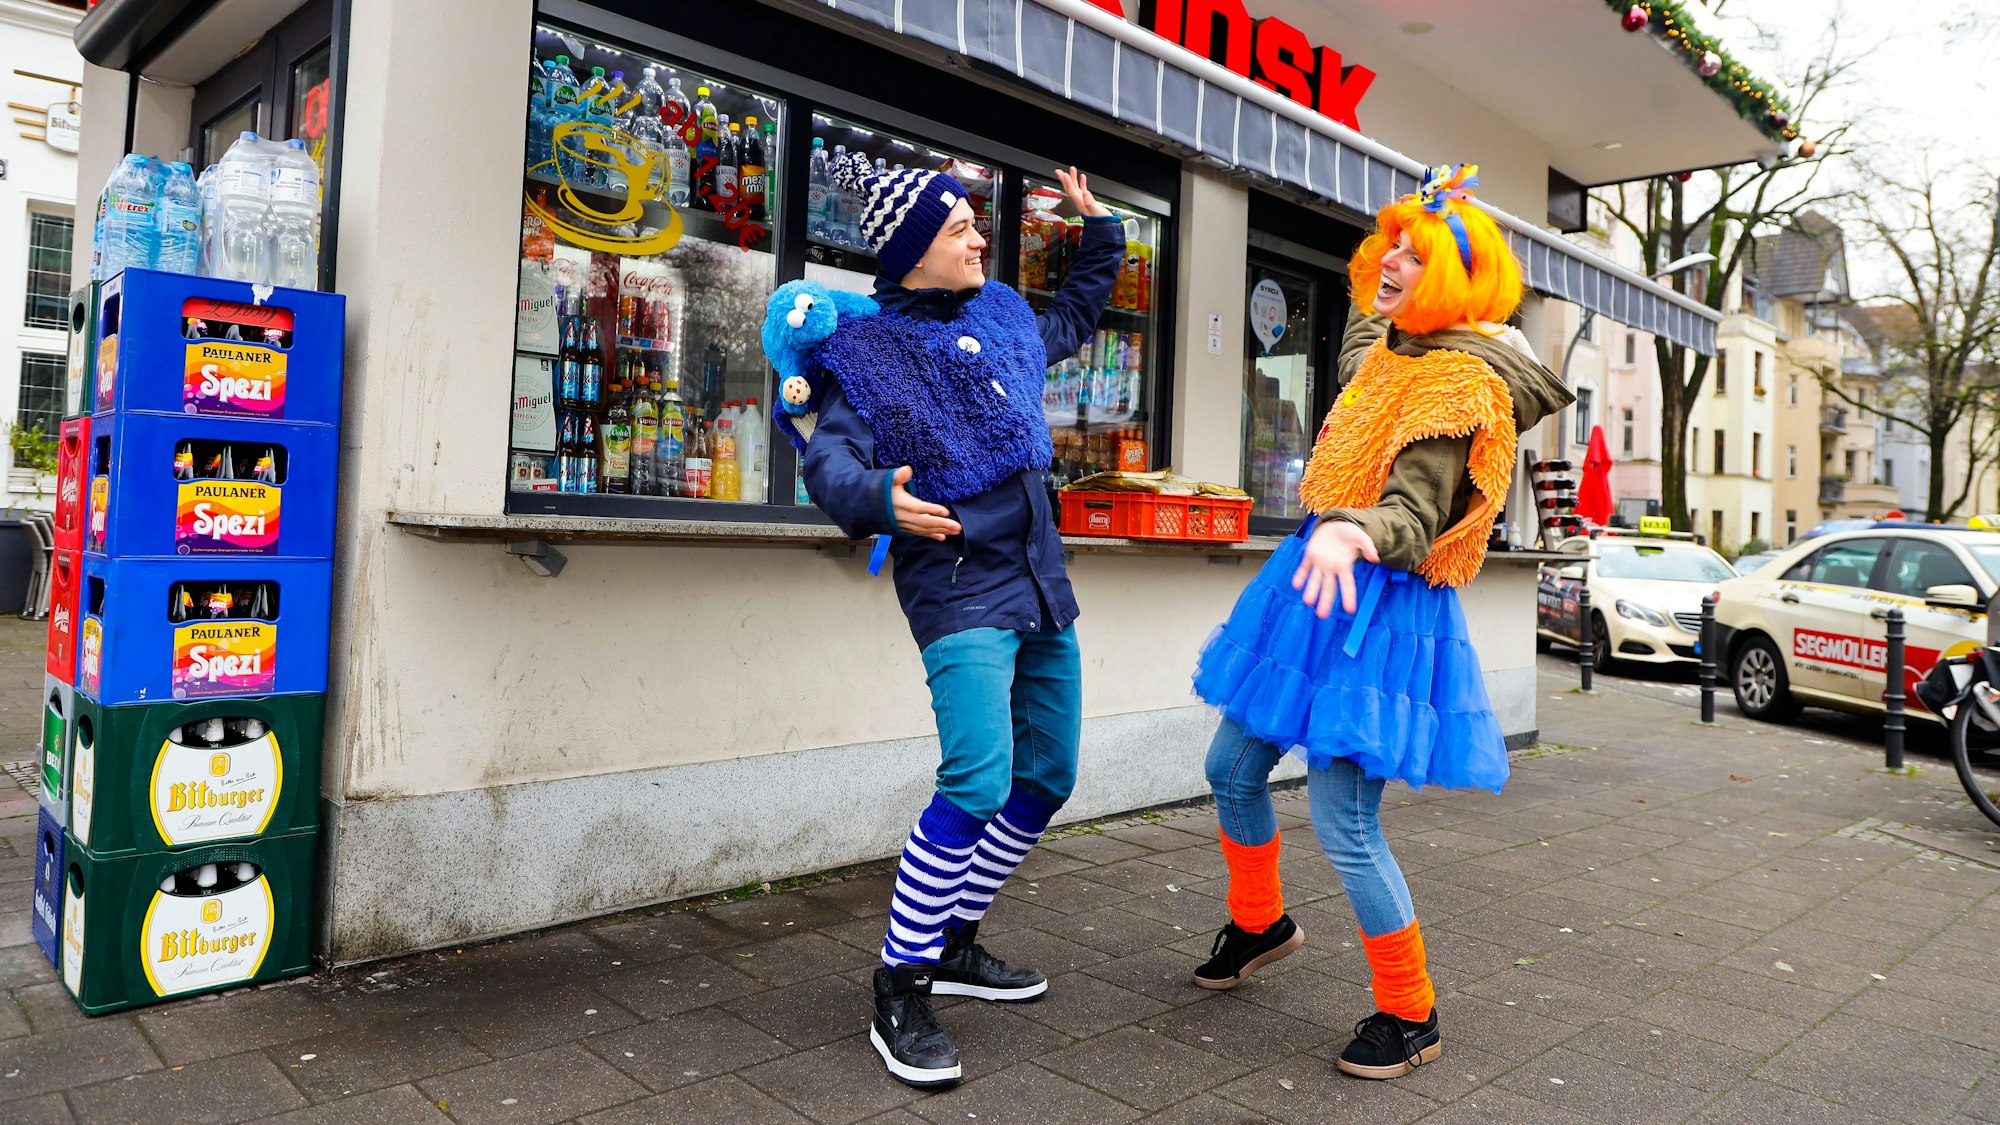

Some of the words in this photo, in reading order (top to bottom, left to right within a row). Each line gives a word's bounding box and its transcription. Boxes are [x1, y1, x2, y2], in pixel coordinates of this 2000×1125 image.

[1081, 0, 1376, 132] OSK
[51, 117, 80, 133] Bitbur
[659, 100, 701, 147] ab
[202, 346, 271, 363] PAULANER
[200, 364, 271, 403] Spezi
[195, 486, 266, 498] PAULANER
[193, 503, 265, 540] Spezi
[1644, 520, 1670, 530] TAXI
[191, 626, 261, 640] PAULANER
[189, 645, 261, 682] Spezi
[166, 780, 265, 813] Bitburger
[157, 927, 257, 963] Bitburger
